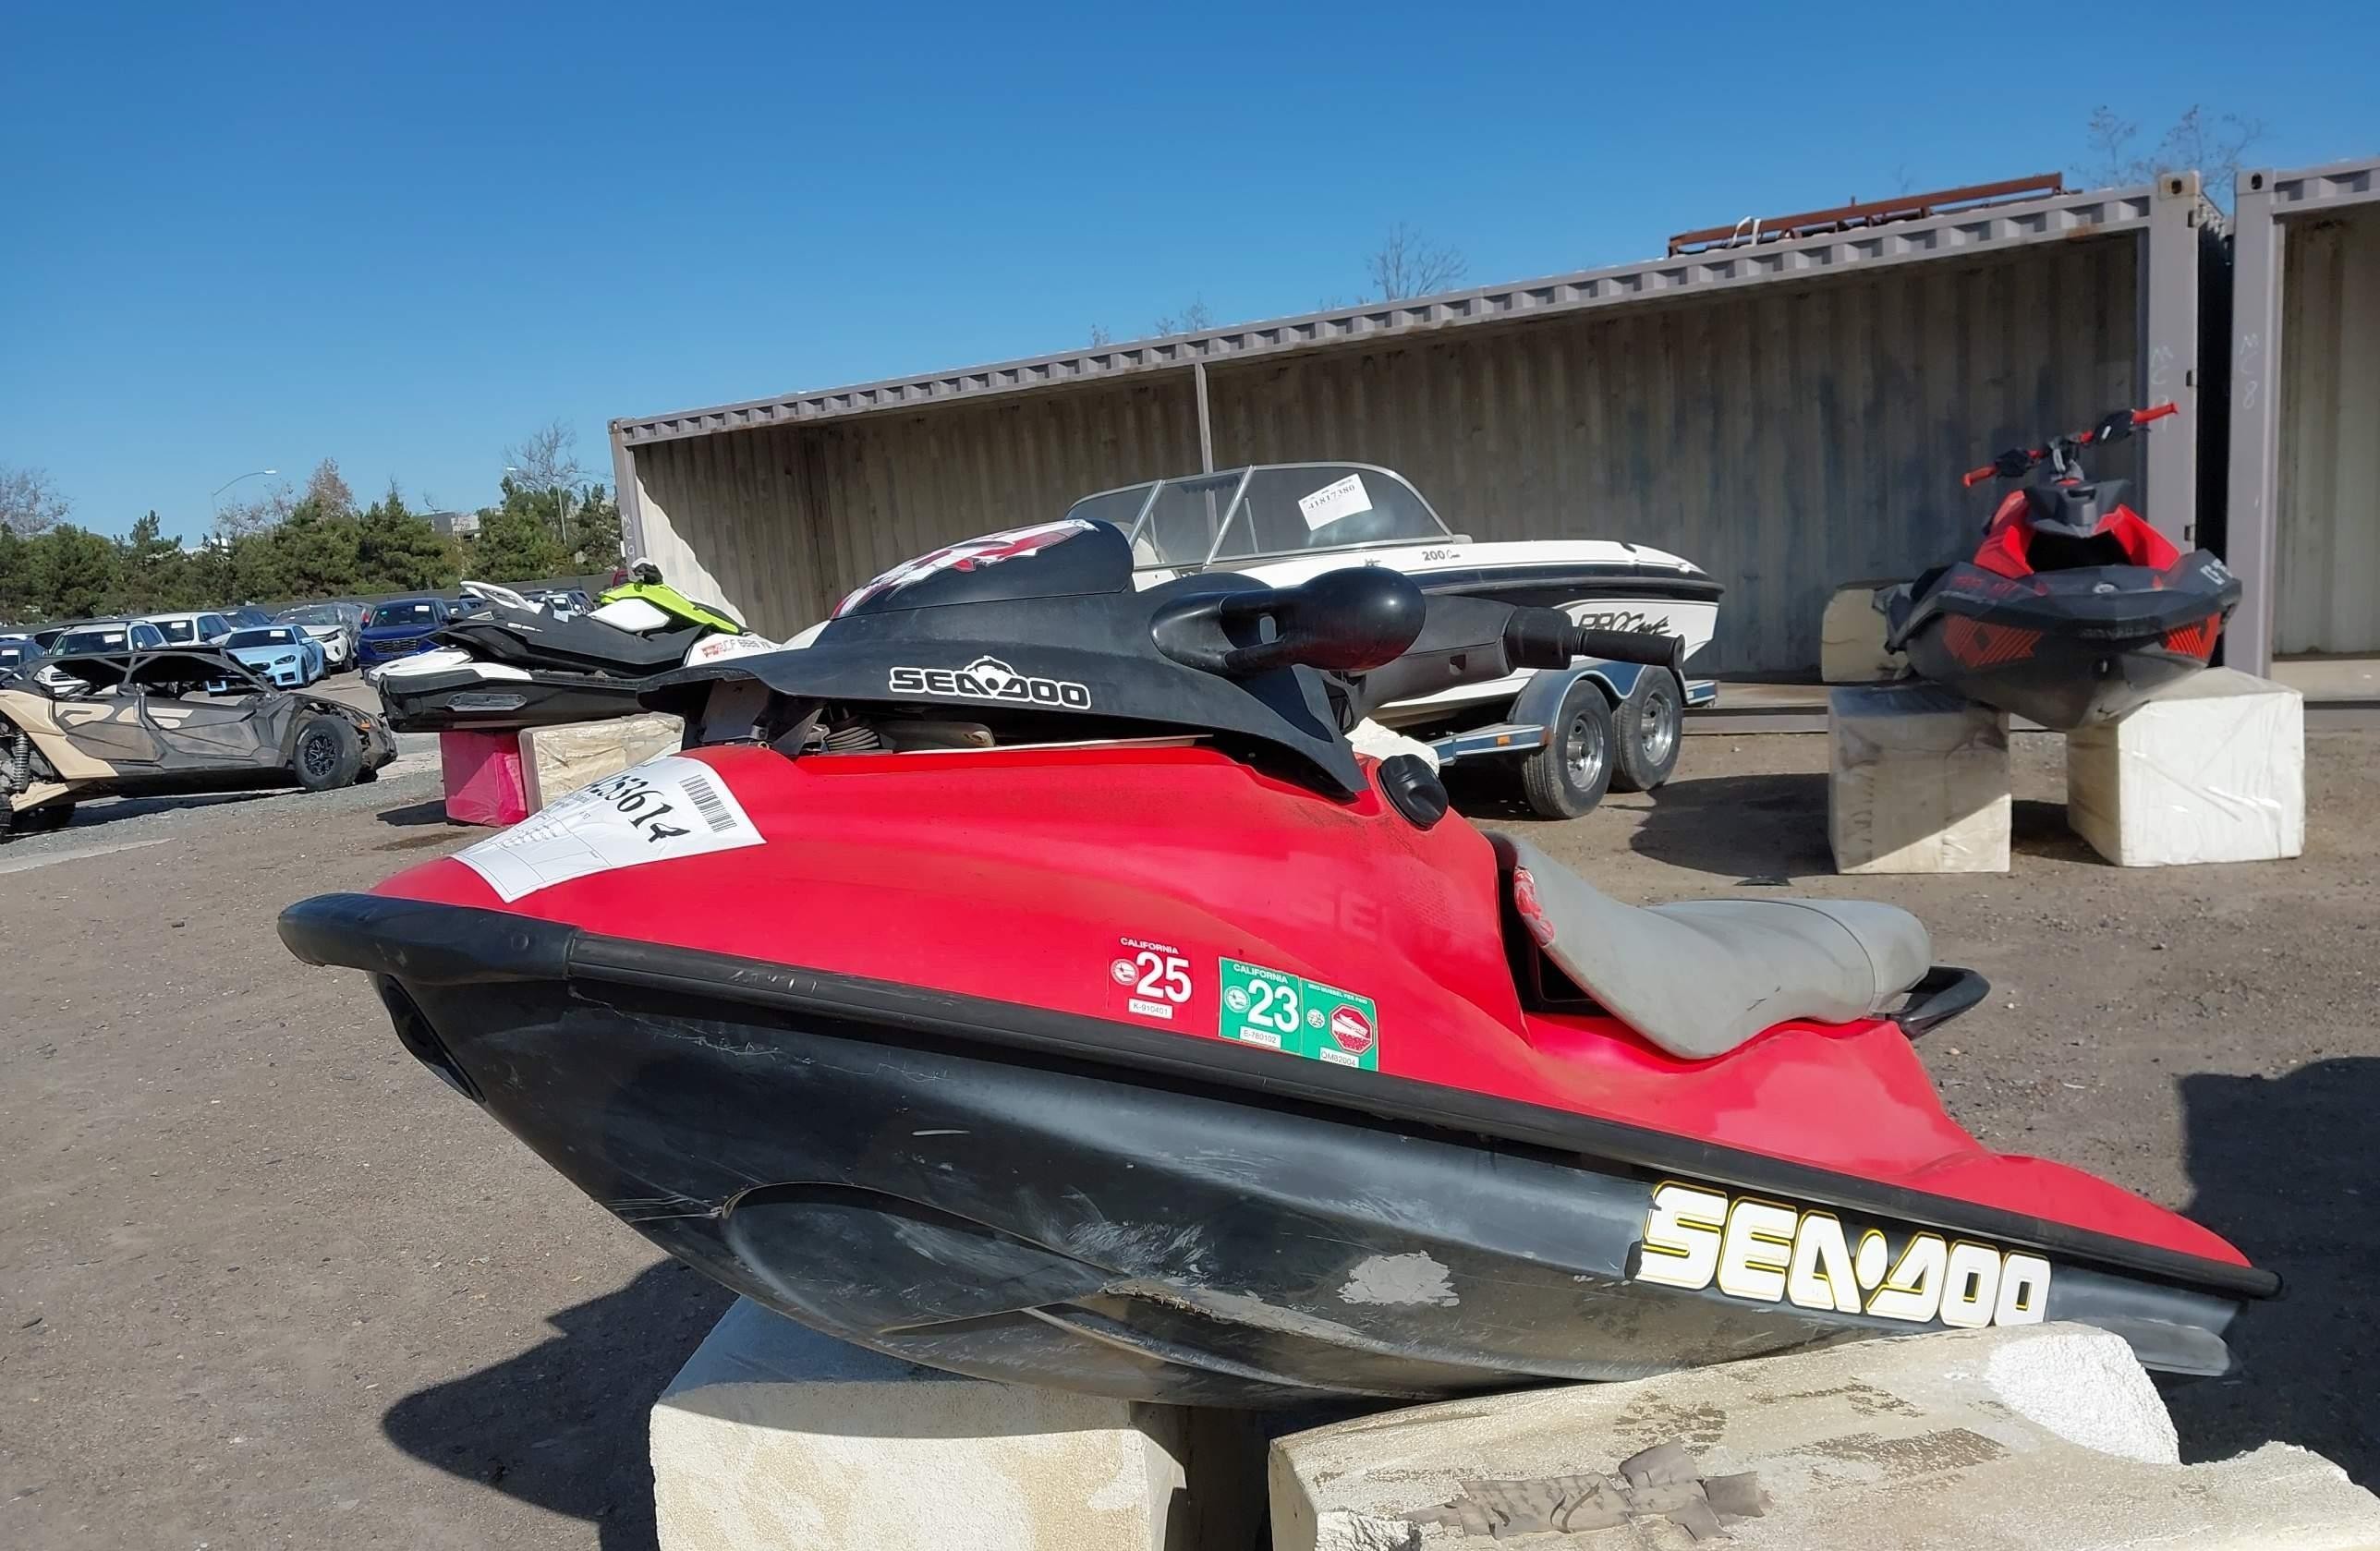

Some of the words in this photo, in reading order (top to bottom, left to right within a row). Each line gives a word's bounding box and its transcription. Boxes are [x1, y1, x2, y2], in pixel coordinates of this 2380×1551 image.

[1422, 551, 1446, 562] 200
[1120, 937, 1180, 955] CALIFORNIA
[1135, 951, 1193, 1003] 25
[1232, 963, 1288, 985] CALIFORNIA
[1247, 978, 1300, 1034] 23
